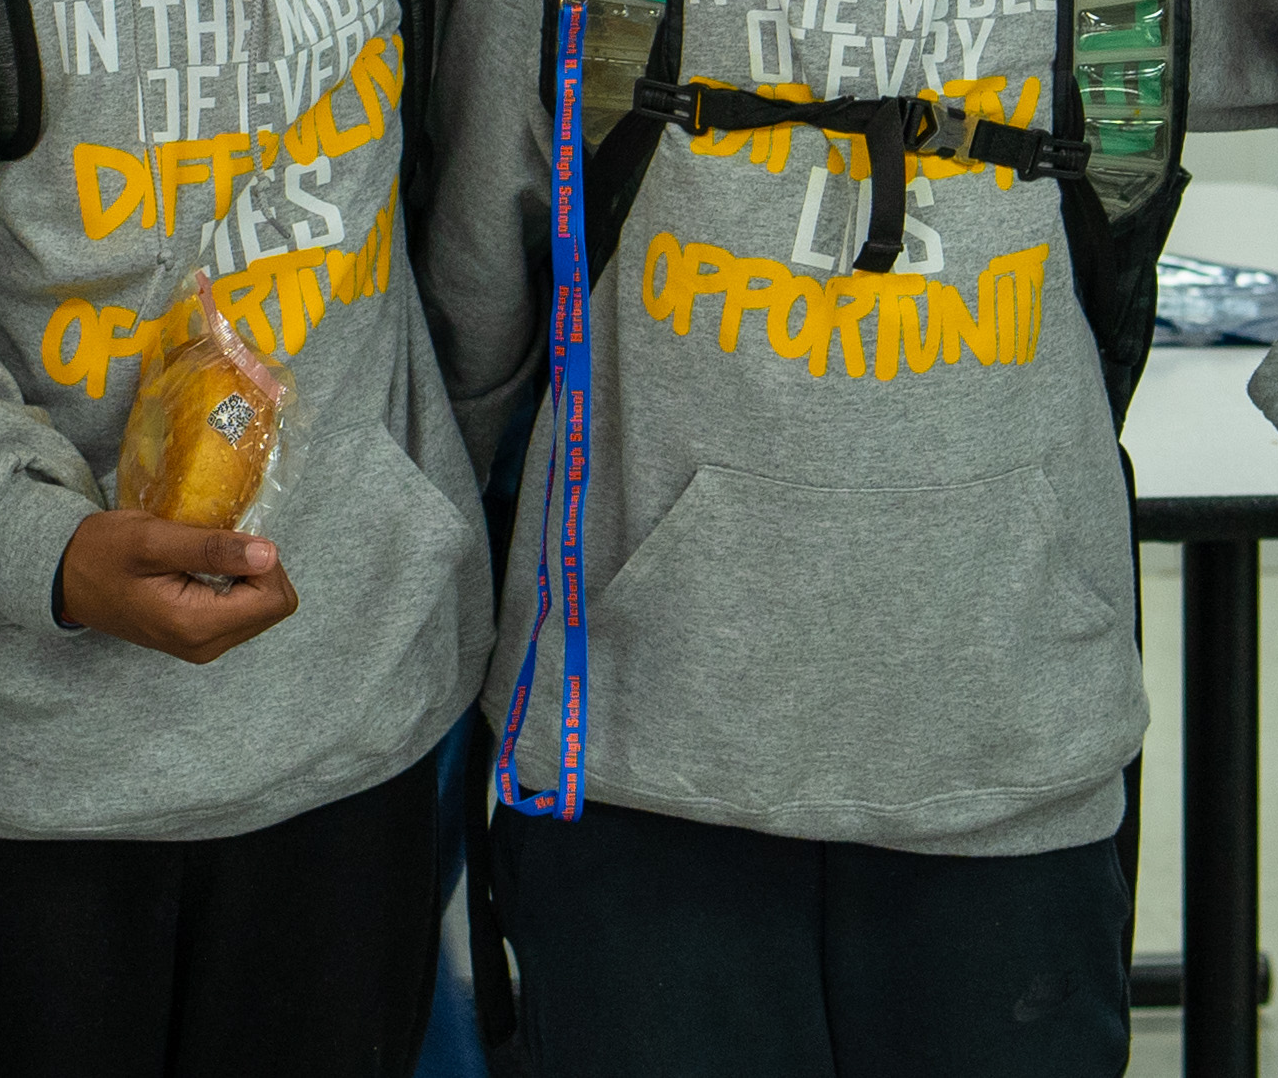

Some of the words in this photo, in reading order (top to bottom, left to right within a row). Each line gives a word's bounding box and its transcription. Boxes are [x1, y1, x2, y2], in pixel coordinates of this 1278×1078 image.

[137, 65, 221, 143] OF
[562, 79, 577, 139] Lehman
[557, 145, 573, 180] High
[559, 186, 572, 238] School
[570, 390, 583, 441] School
[569, 447, 585, 481] High
[565, 485, 581, 546] Lehman
[567, 571, 580, 628] Herbert
[566, 675, 580, 727] School
[565, 733, 580, 767] High
